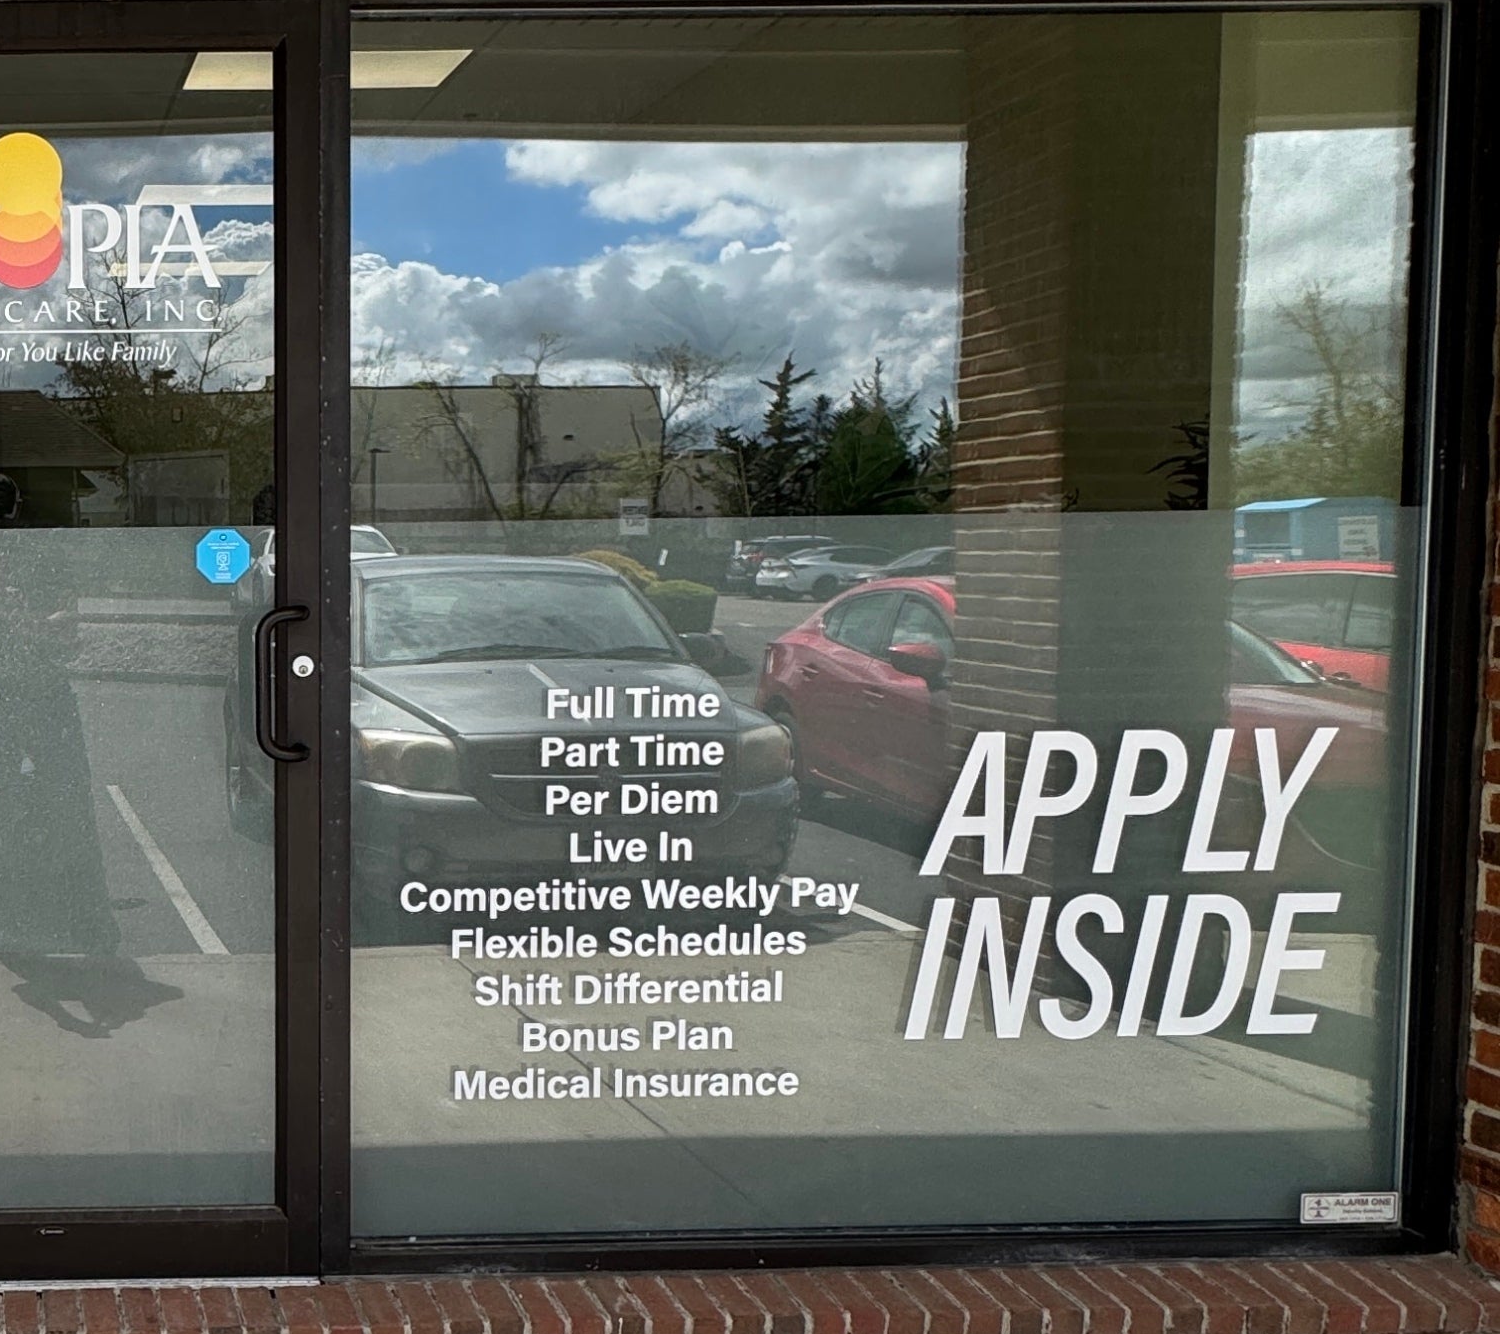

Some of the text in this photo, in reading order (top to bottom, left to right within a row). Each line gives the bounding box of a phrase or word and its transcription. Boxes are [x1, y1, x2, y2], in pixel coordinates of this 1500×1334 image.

[145, 299, 224, 323] INC.
[21, 340, 58, 362] You
[64, 340, 104, 362] Like
[111, 339, 177, 369] Family
[547, 685, 720, 720] Full Time
[541, 733, 724, 767] Part Time
[546, 782, 718, 815] Per Diem
[920, 727, 1338, 876] APPLY
[569, 830, 694, 864] Live In
[400, 876, 860, 920] Competitive Weekly Pay
[451, 924, 807, 959] Flexible Schedules
[904, 892, 1340, 1040] INSIDE
[474, 970, 783, 1007] Shift Differential
[522, 1019, 733, 1053] Bonus Plan
[454, 1066, 799, 1100] Medical Insurance
[1334, 1197, 1392, 1207] ALARM ONE
